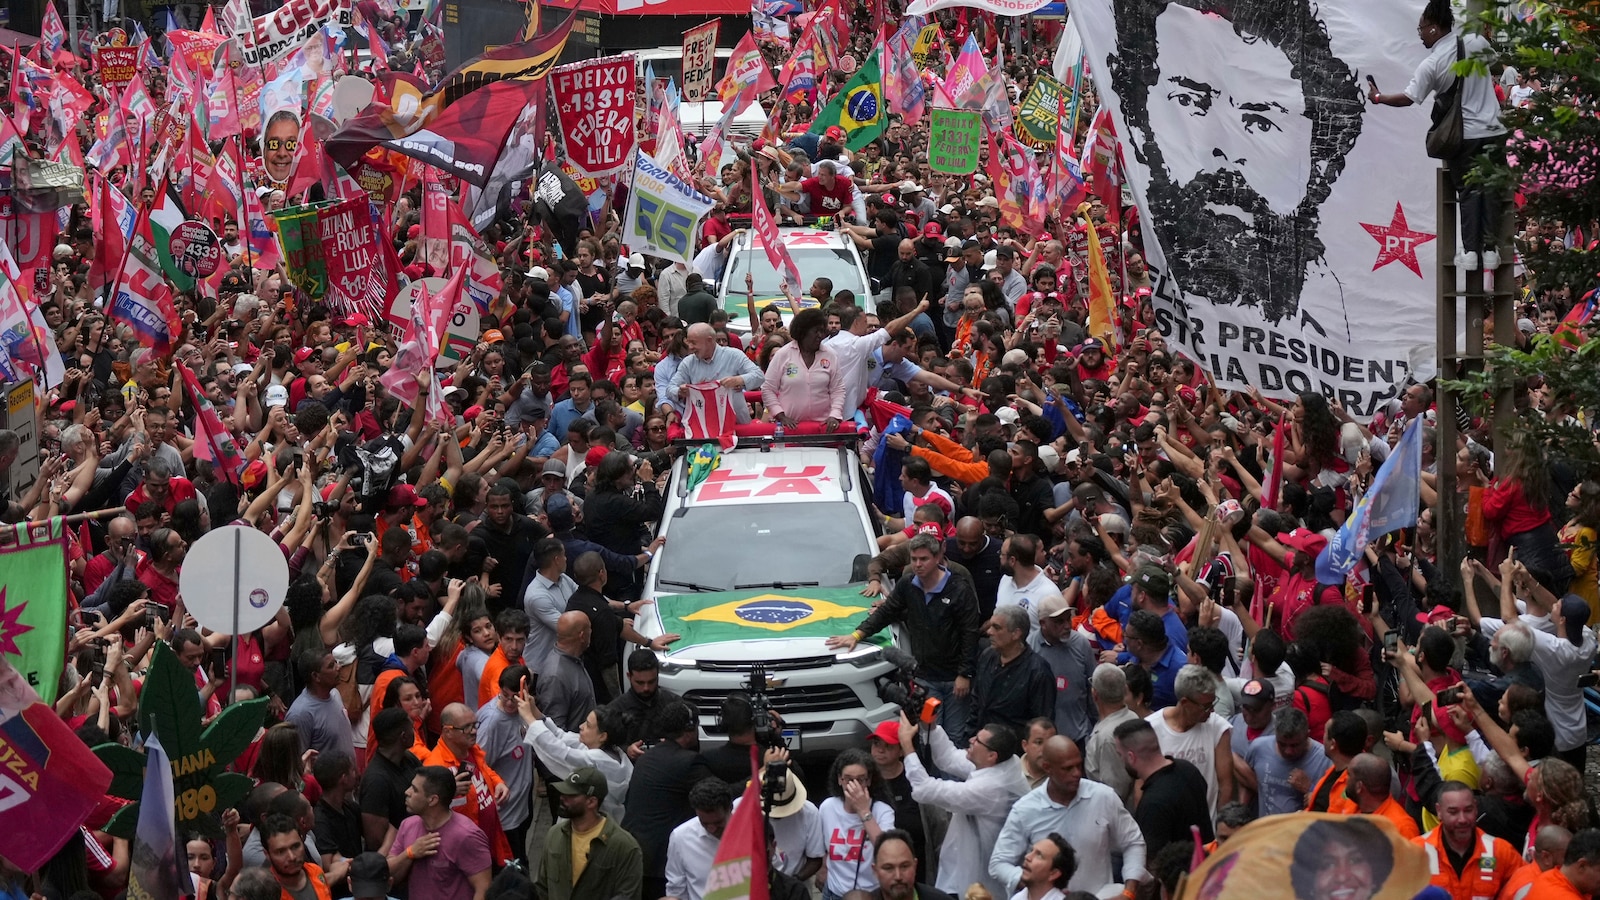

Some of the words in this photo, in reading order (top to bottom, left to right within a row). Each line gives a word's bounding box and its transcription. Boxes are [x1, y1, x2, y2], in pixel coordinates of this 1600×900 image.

[101, 50, 116, 61] POR
[106, 58, 128, 67] NOVA
[102, 67, 136, 75] CULTURA
[559, 65, 629, 94] FREIXO
[571, 87, 625, 113] 1331
[689, 88, 699, 99] DO
[938, 116, 975, 129] FREIXO
[1031, 108, 1059, 125] 6577
[268, 139, 280, 151] 13
[594, 127, 612, 147] DO
[941, 129, 970, 146] 1331
[586, 143, 622, 165] LULA
[934, 140, 975, 156] FEDERAL
[935, 155, 946, 166] DO
[947, 157, 967, 168] LULA
[637, 175, 666, 195] ADOR
[664, 172, 713, 205] PAULO
[181, 224, 210, 236] Bandeira
[185, 242, 219, 260] 4333
[1385, 234, 1415, 255] PT
[342, 247, 371, 274] LULA
[1258, 363, 1312, 397] DO
[918, 525, 939, 535] LULA
